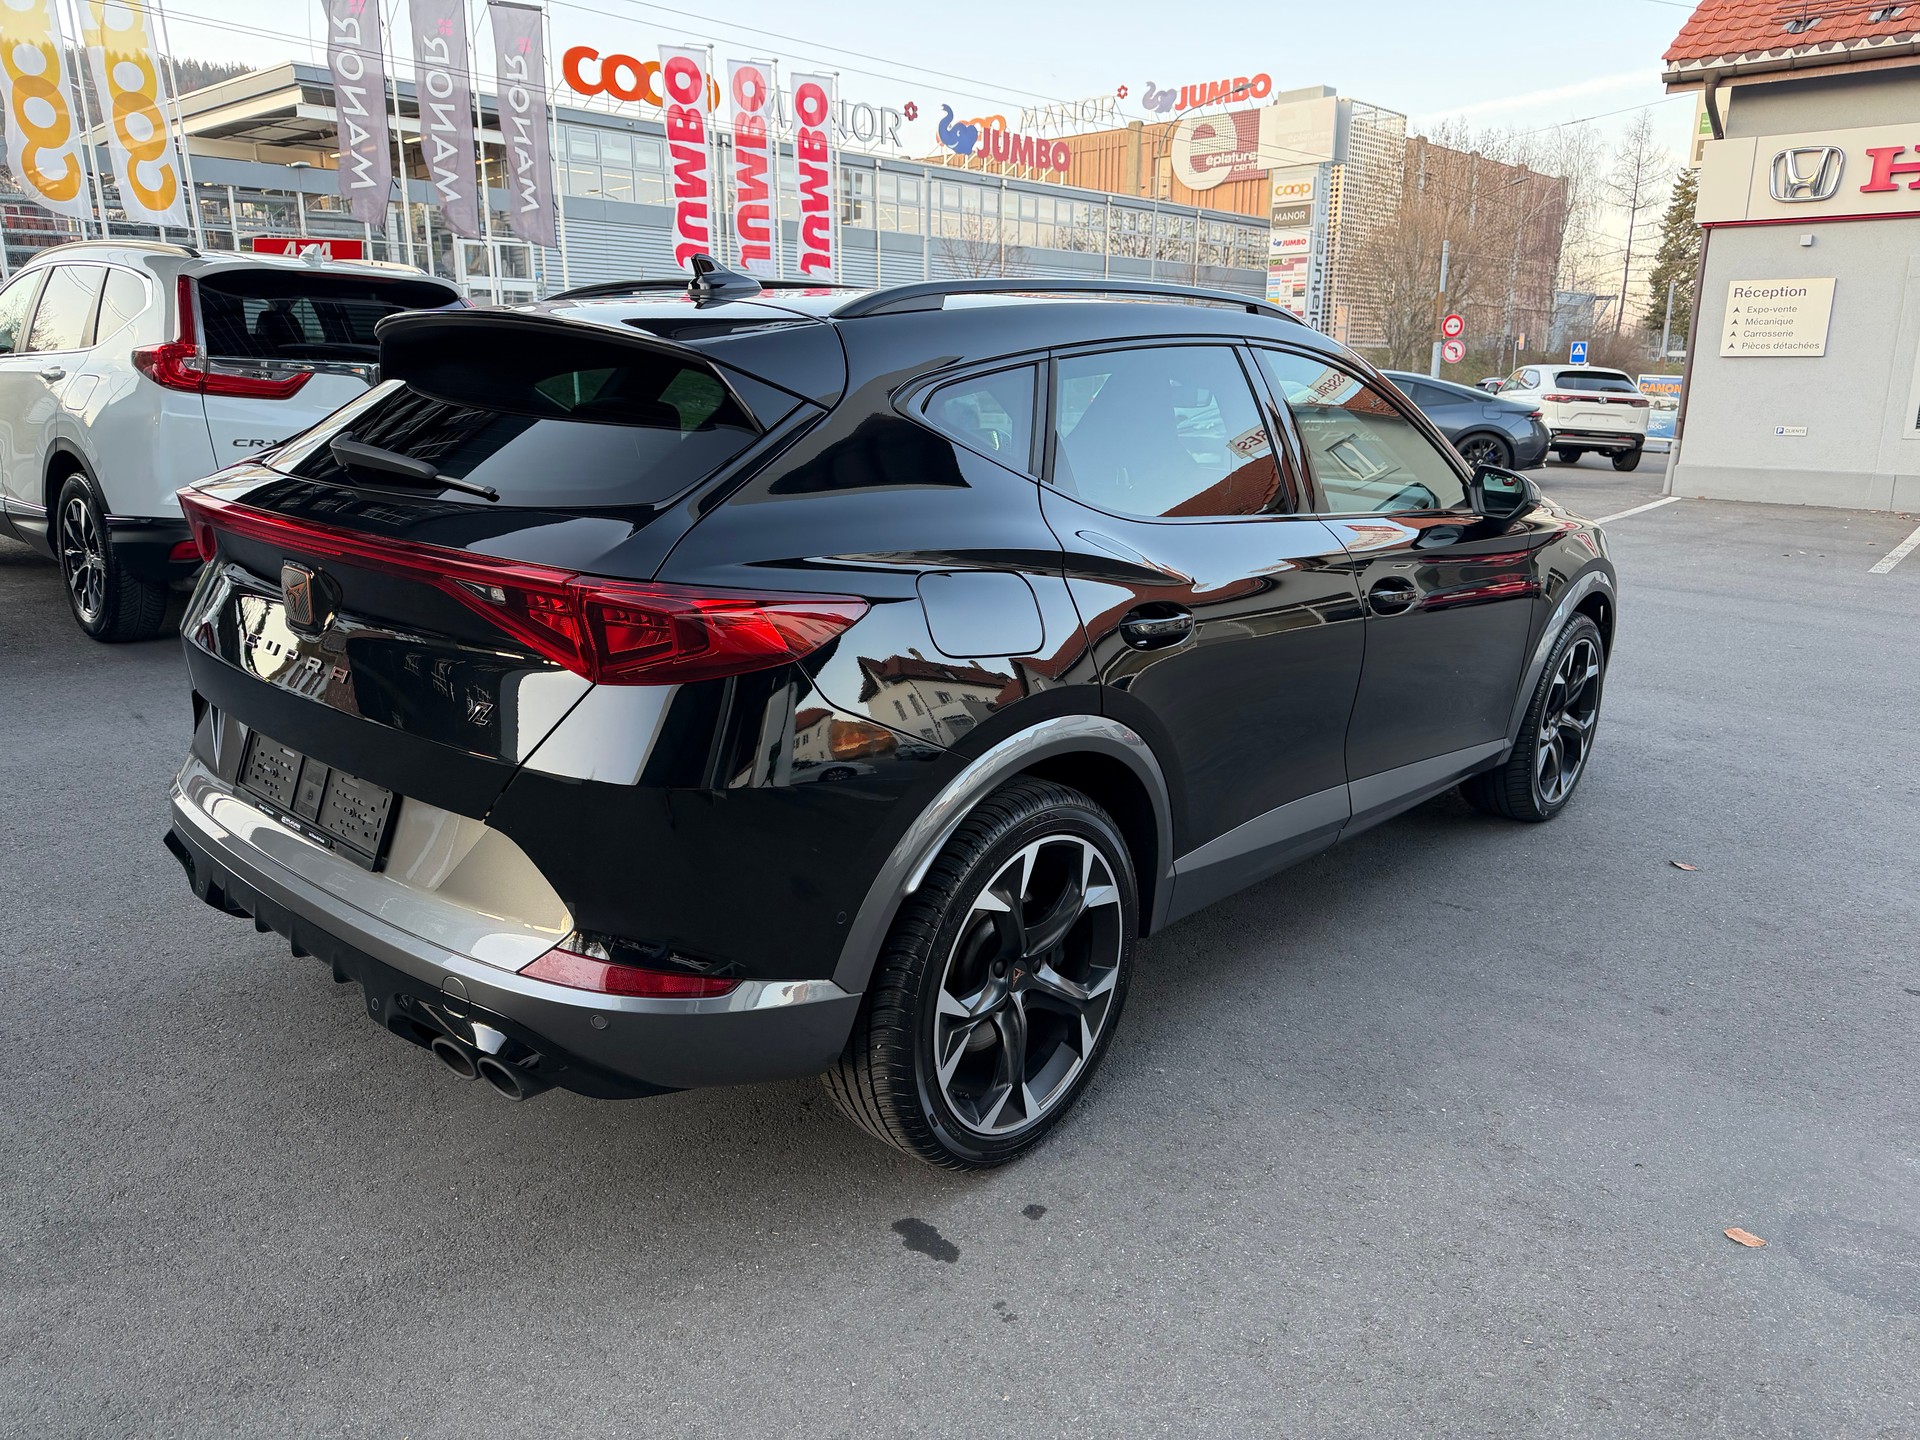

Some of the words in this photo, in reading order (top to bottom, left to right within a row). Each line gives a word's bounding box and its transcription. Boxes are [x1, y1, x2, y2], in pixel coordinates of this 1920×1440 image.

[1175, 73, 1271, 111] JUMBO
[1020, 95, 1116, 132] MANOR
[977, 127, 1070, 172] JUMBO
[1275, 183, 1311, 196] coop
[1275, 211, 1306, 221] MANOR
[1282, 239, 1306, 247] JUMBO
[283, 241, 333, 261] 44
[1733, 286, 1808, 299] Réception
[1747, 306, 1798, 314] Expo-vente
[1745, 318, 1794, 326] Mécanique
[1743, 330, 1794, 338] Carrosserie
[1741, 342, 1771, 350] Pièces
[1773, 342, 1820, 350] détachées
[246, 633, 351, 684] CUPRA
